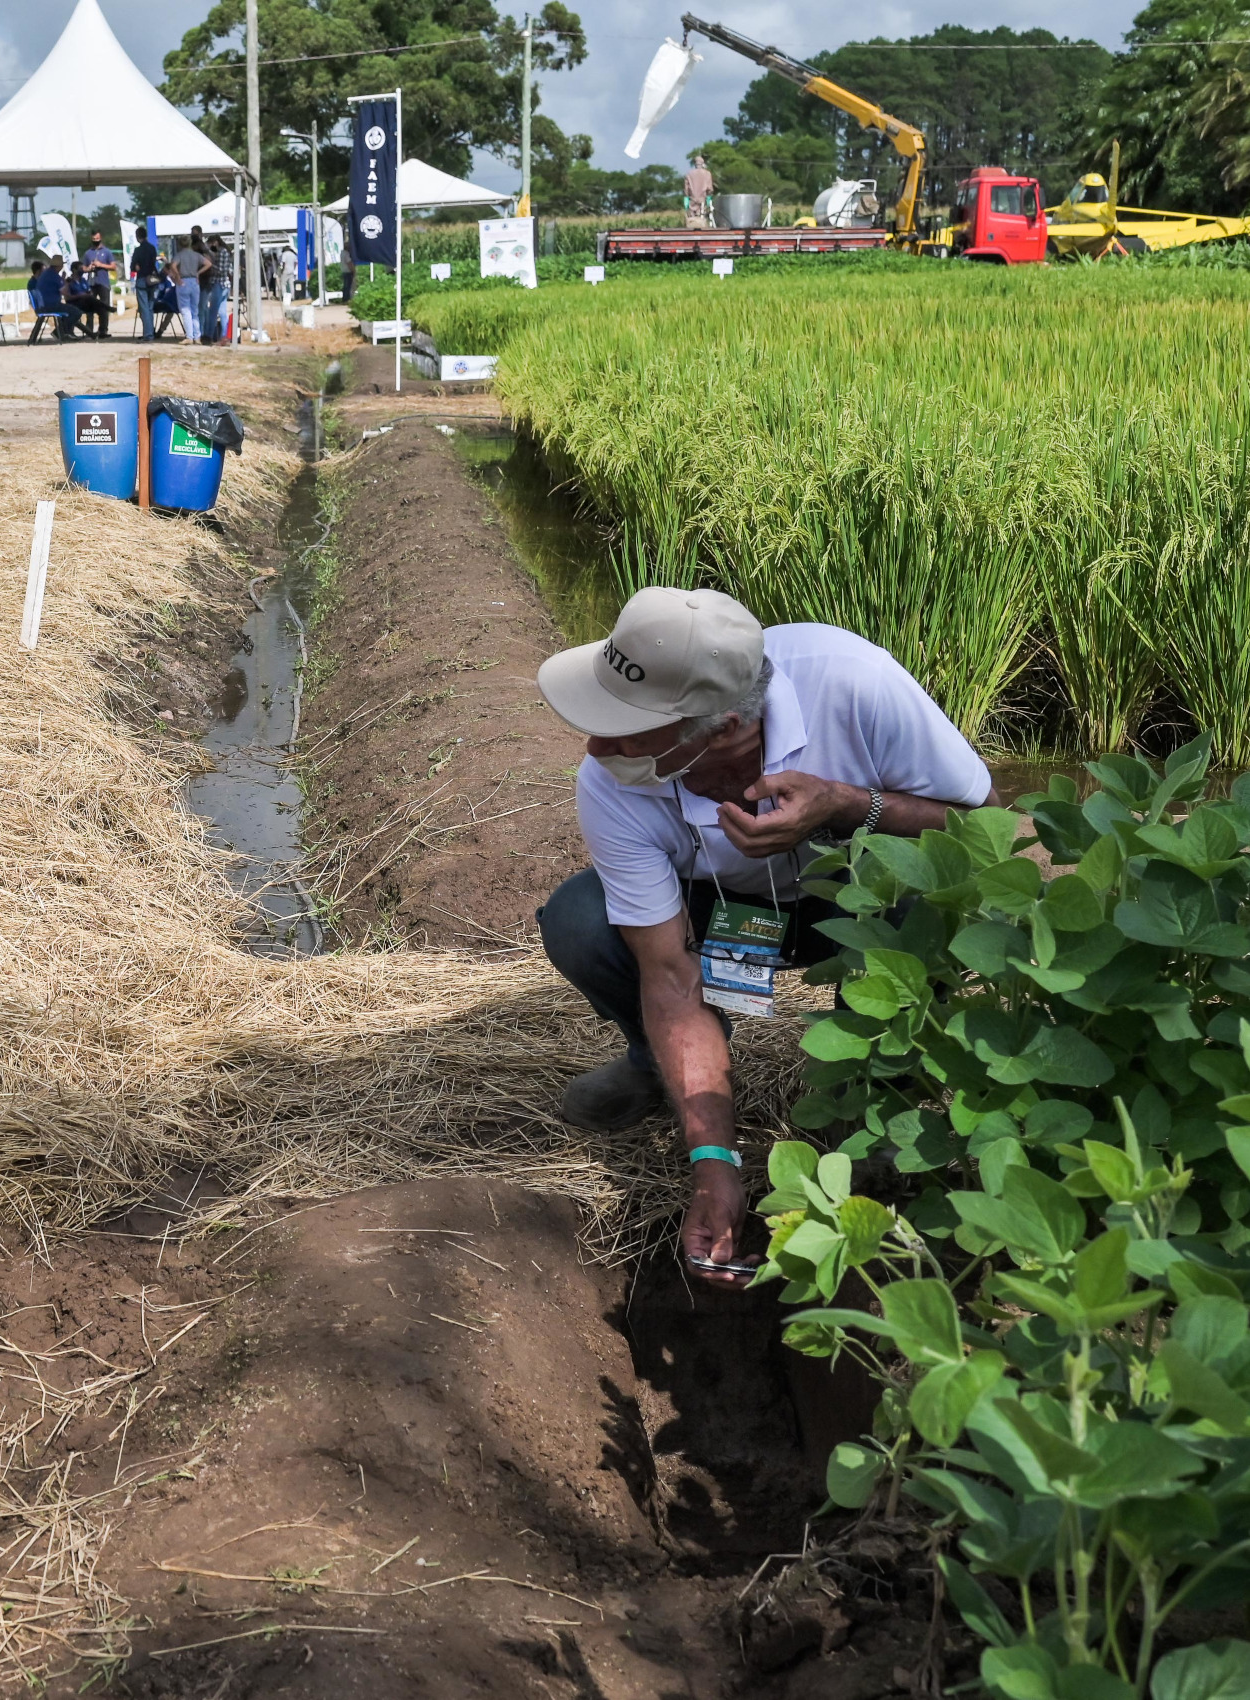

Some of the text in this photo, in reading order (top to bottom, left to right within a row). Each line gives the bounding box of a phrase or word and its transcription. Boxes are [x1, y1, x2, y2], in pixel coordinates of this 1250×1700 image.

[366, 158, 378, 205] FAEM
[81, 427, 110, 435] RESÍDUOS
[79, 434, 112, 442] ORGÂNICOS
[174, 444, 208, 454] RECICLÁVEL
[604, 638, 645, 682] NIO
